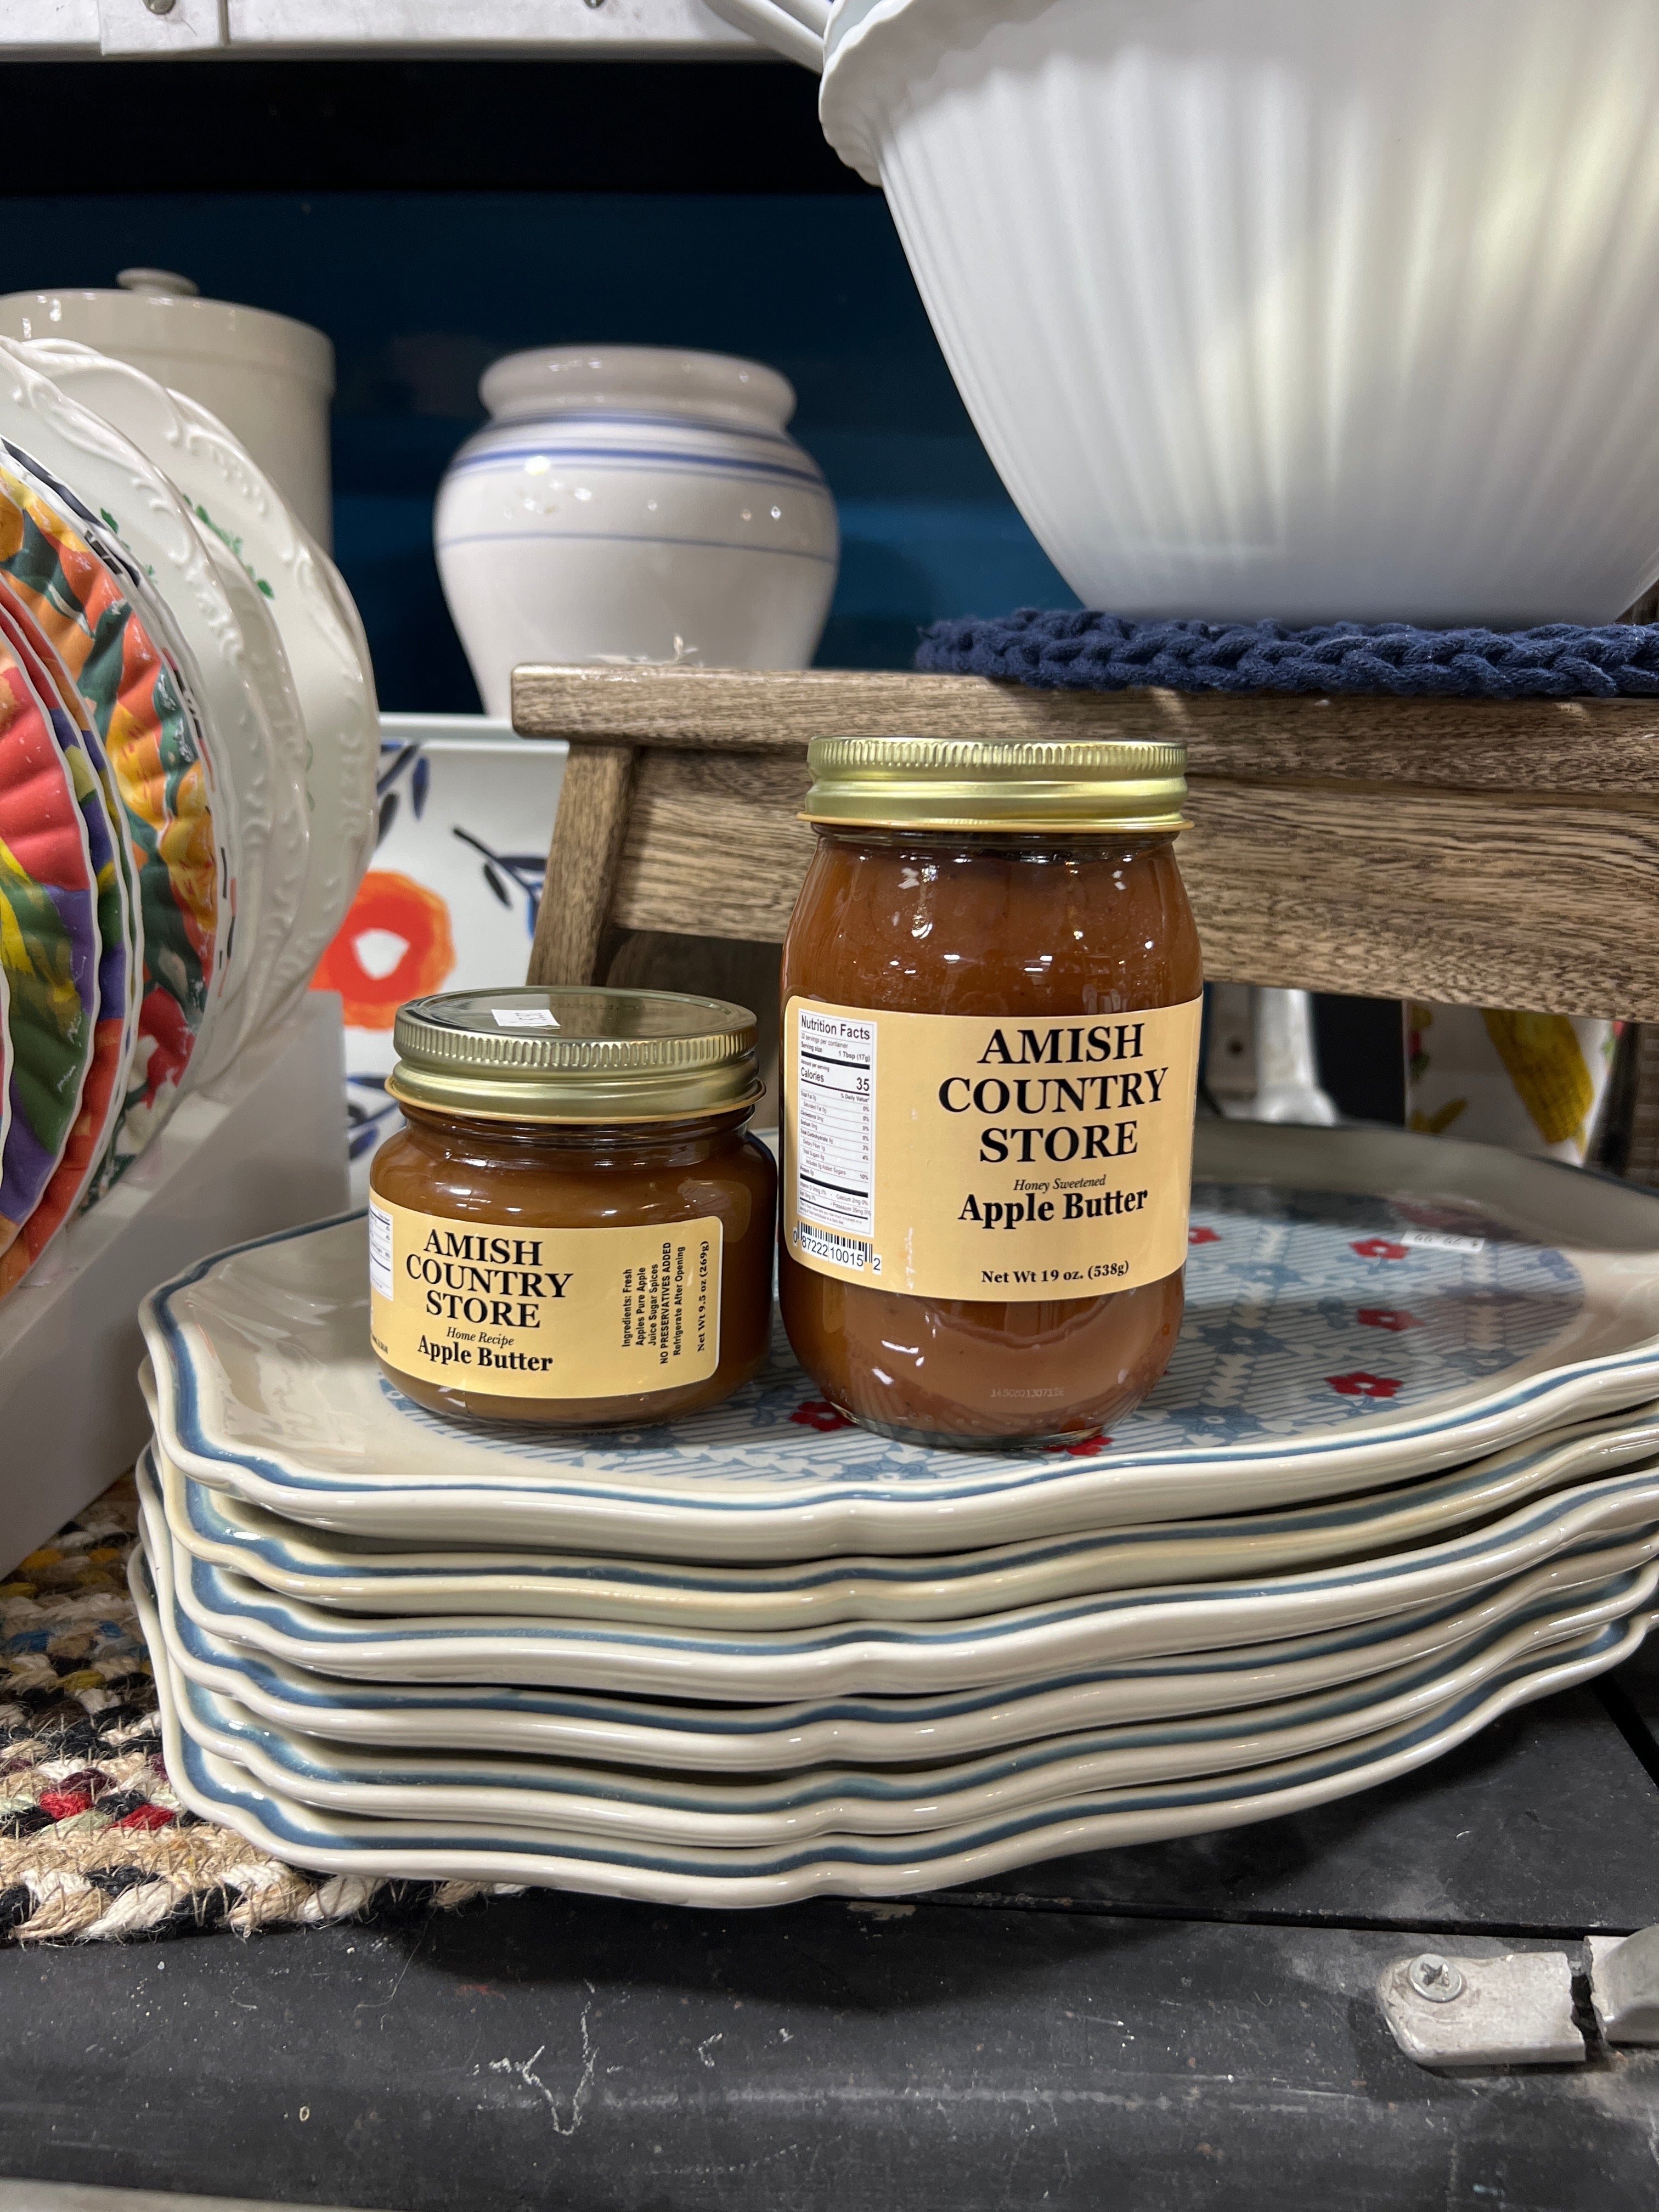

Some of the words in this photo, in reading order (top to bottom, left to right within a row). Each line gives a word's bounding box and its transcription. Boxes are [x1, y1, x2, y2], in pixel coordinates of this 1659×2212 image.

[802, 1015, 837, 1035] Nutrition
[840, 1024, 870, 1040] Facts
[801, 1041, 814, 1052] Serving
[828, 1040, 848, 1049] container
[977, 1023, 1145, 1064] AMISH
[843, 1051, 855, 1060] Tbsp
[857, 1054, 870, 1063] (17g)
[801, 1067, 824, 1082] Calories
[856, 1077, 870, 1091] 35
[939, 1067, 1169, 1114] COUNTRY
[980, 1120, 1138, 1163] STORE
[1013, 1180, 1049, 1194] Honey
[1053, 1174, 1107, 1189] Sweetened
[957, 1193, 1054, 1229] Apple
[1062, 1189, 1148, 1219] Butter
[423, 1228, 543, 1266] AMISH
[662, 1242, 672, 1273] ADDED
[699, 1240, 709, 1277] (269g)
[793, 1231, 797, 1243] 0
[802, 1235, 828, 1257] 87222
[830, 1247, 864, 1267] 10015
[873, 1258, 881, 1271] 2
[406, 1254, 574, 1297] COUNTRY
[675, 1246, 686, 1282] Opening
[981, 1270, 1009, 1283] Net
[1012, 1270, 1036, 1283] Wt
[1041, 1269, 1059, 1282] 19
[1063, 1271, 1084, 1280] oz.
[1087, 1260, 1130, 1280] (538g)
[623, 1268, 633, 1293] Fresh
[636, 1267, 647, 1291] Apple
[649, 1263, 659, 1293] Spices
[701, 1279, 707, 1292] oz
[636, 1294, 645, 1314] Pure
[674, 1284, 682, 1305] After
[426, 1290, 541, 1328] STORE
[648, 1296, 659, 1321] Sugar
[661, 1275, 670, 1348] PRESERVATIVES
[622, 1296, 633, 1347] Ingredients:
[635, 1316, 647, 1346] Apples
[673, 1308, 683, 1356] Refrigerate
[698, 1313, 706, 1332] Wt
[447, 1326, 476, 1342] Home
[478, 1331, 515, 1348] Recipe
[648, 1323, 657, 1346] Juice
[417, 1334, 472, 1365] Apple
[477, 1346, 554, 1371] Butter
[660, 1351, 669, 1364] NO
